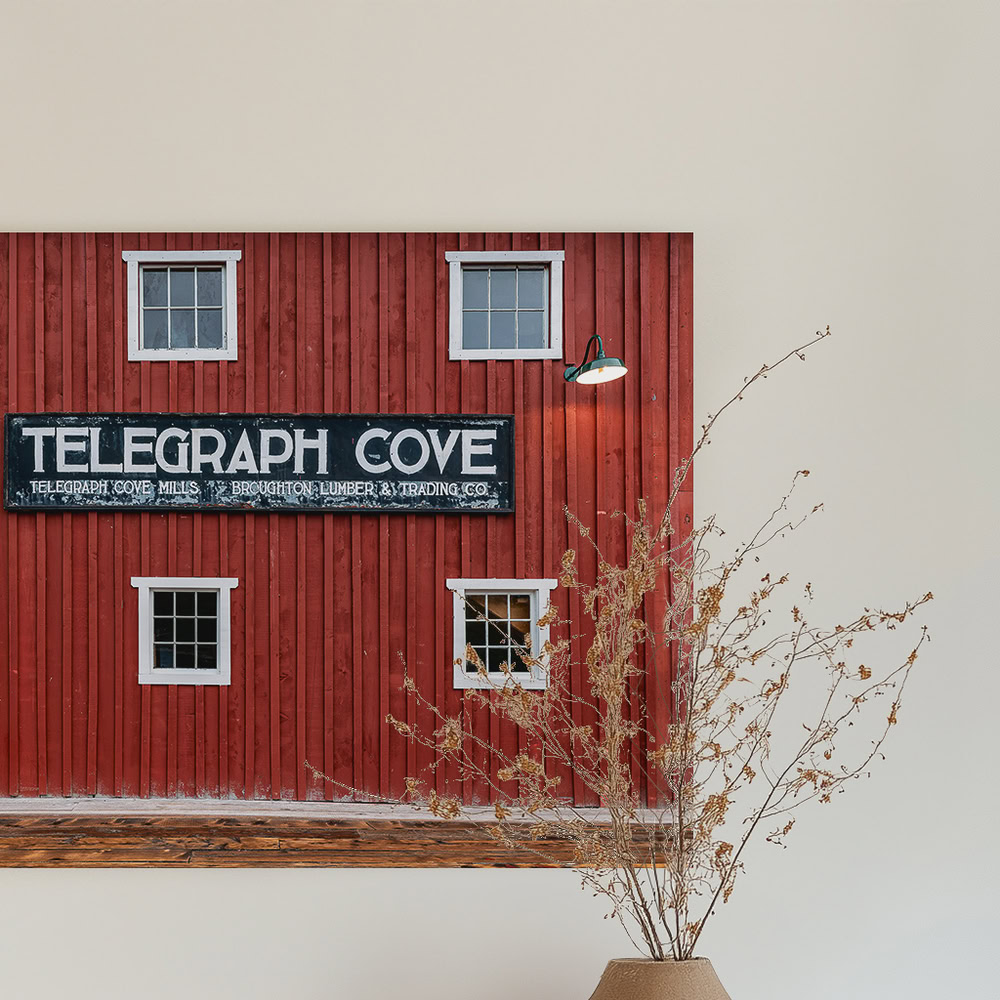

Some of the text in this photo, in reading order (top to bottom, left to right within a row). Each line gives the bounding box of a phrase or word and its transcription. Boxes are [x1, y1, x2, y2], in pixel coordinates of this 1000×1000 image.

[21, 427, 498, 475] TELEGRAPH COVE
[29, 480, 108, 495] TELEGRAPH
[113, 480, 151, 495] COVE
[158, 480, 200, 495] MILLS
[231, 481, 313, 496] BROUGHTON
[319, 481, 375, 496] LUMBER
[381, 482, 392, 496] &
[401, 482, 458, 496] TRADING
